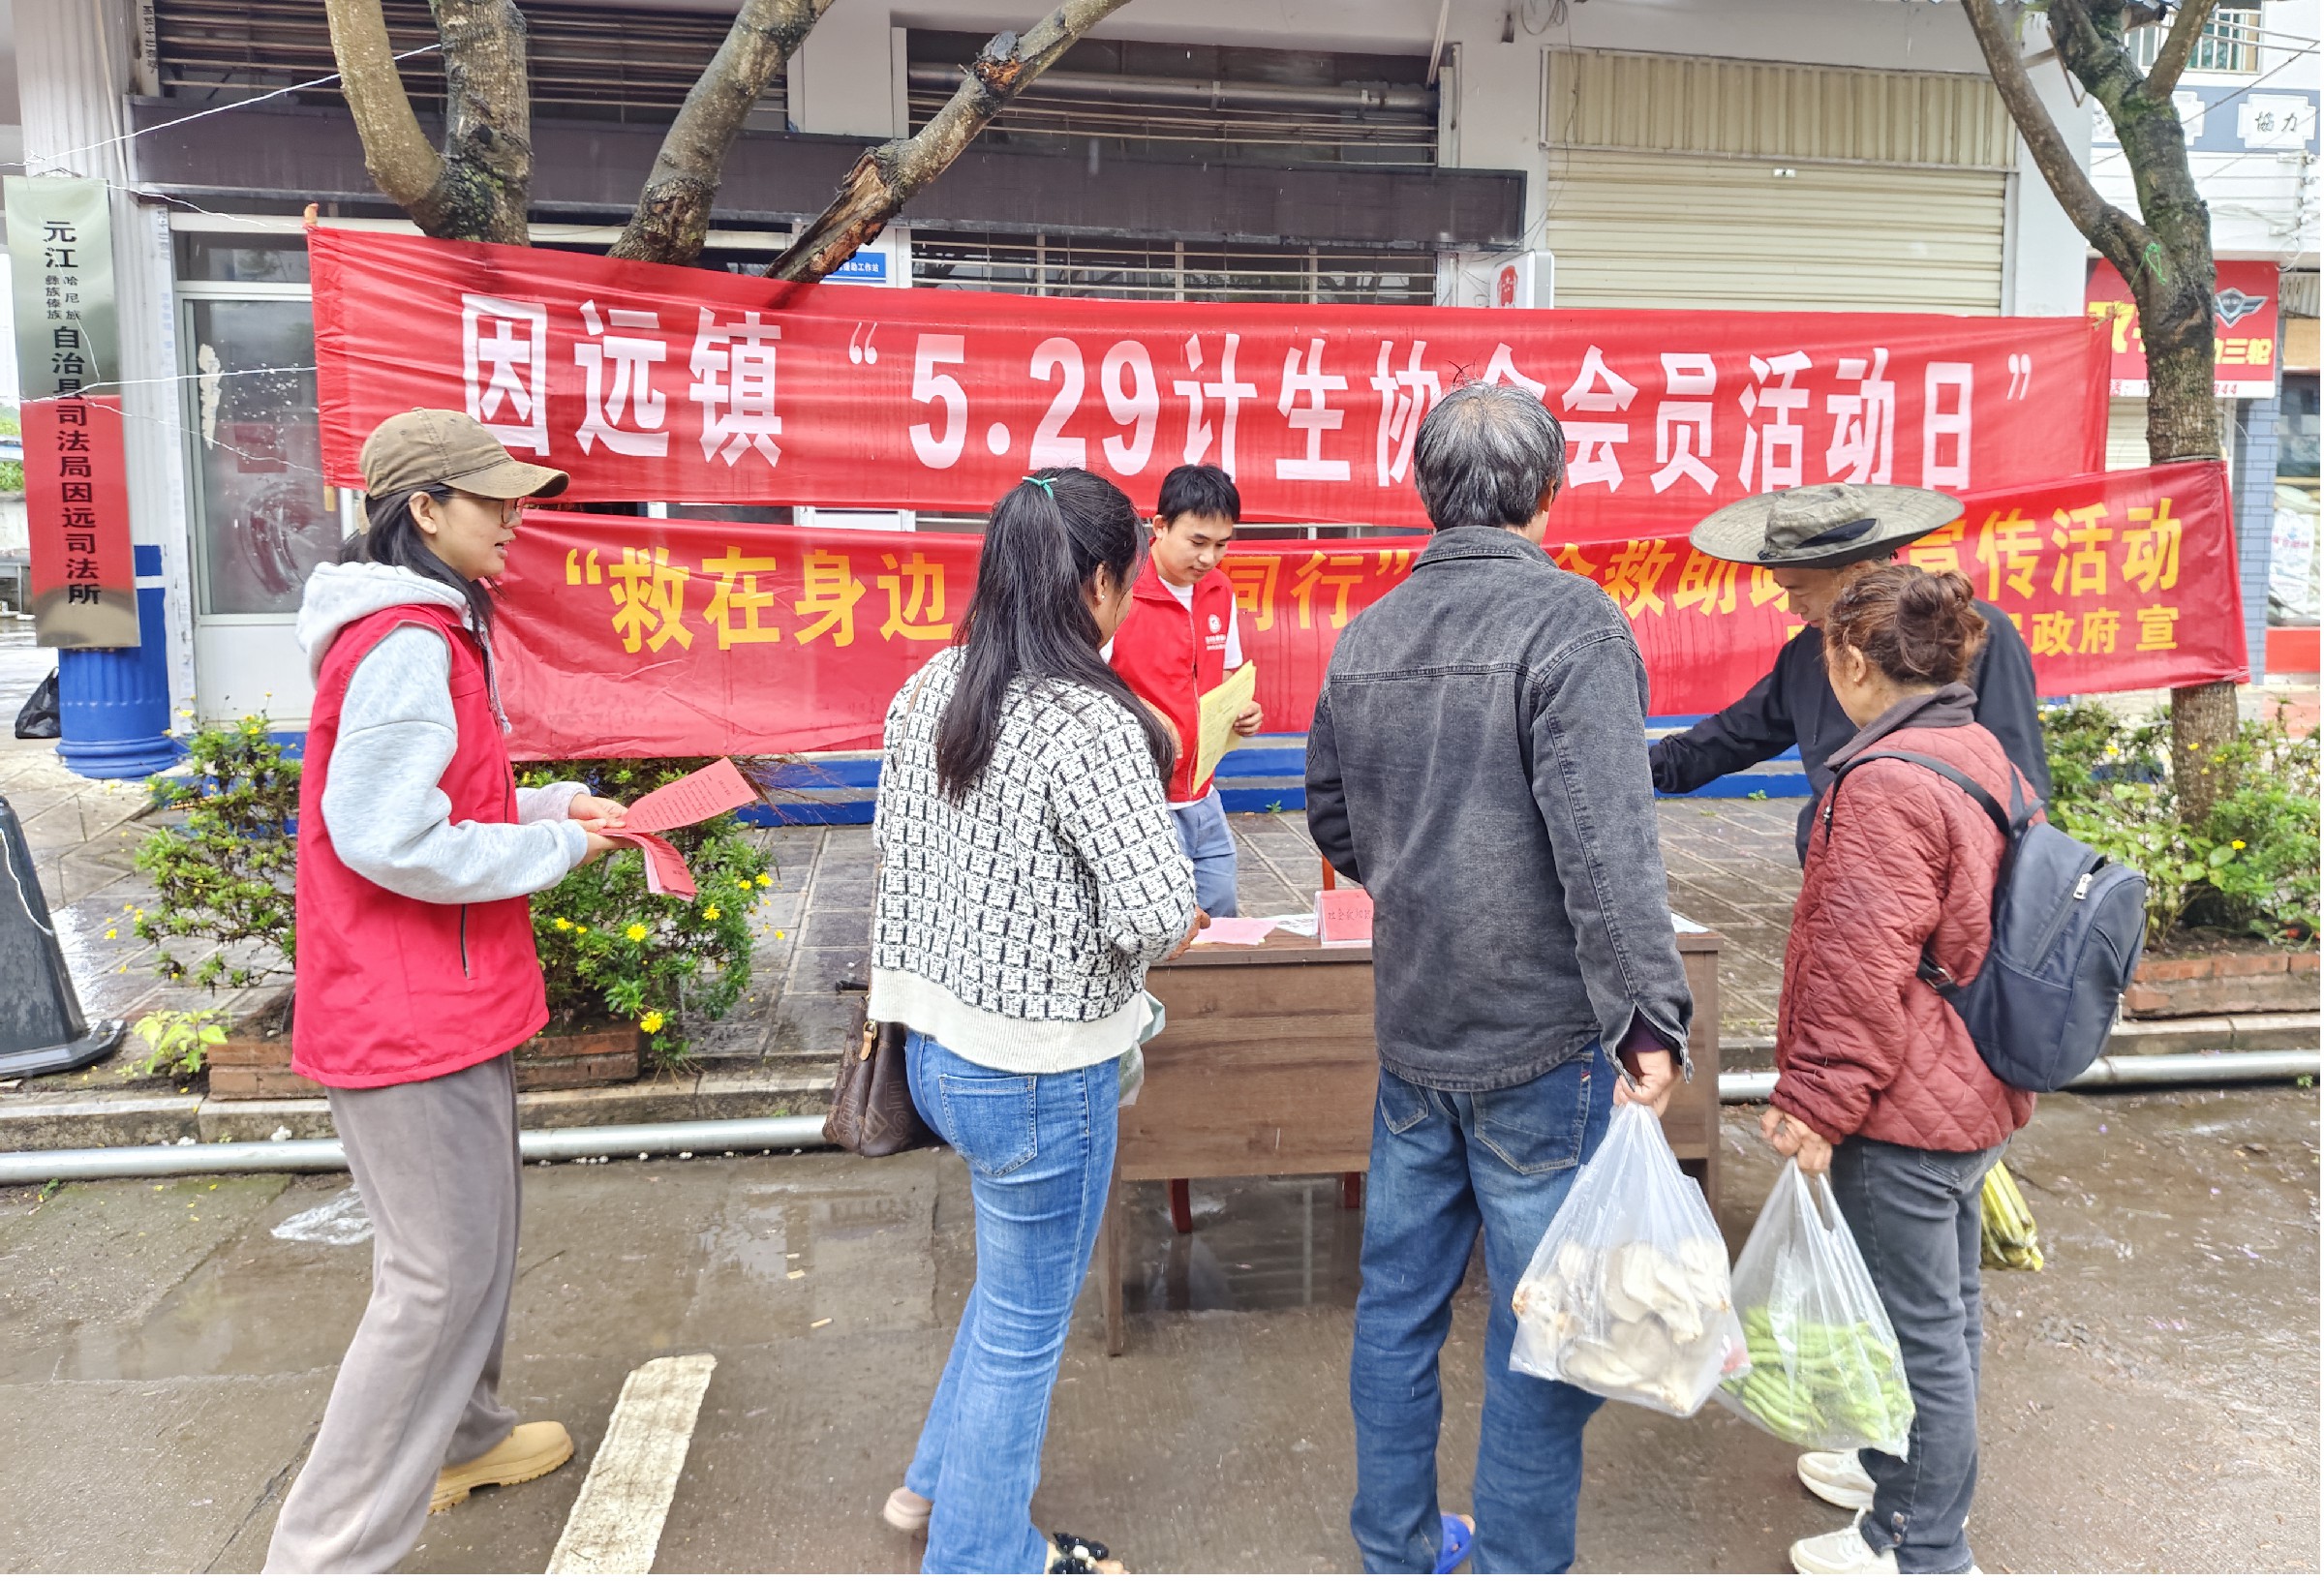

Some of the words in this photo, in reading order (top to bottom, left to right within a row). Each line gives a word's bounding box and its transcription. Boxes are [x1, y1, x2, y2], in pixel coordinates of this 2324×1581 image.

[43, 220, 77, 268] 元江
[839, 261, 879, 272] 援助工作站
[2215, 337, 2272, 365] 三轮
[51, 325, 102, 605] 自治县司法局因远司法所
